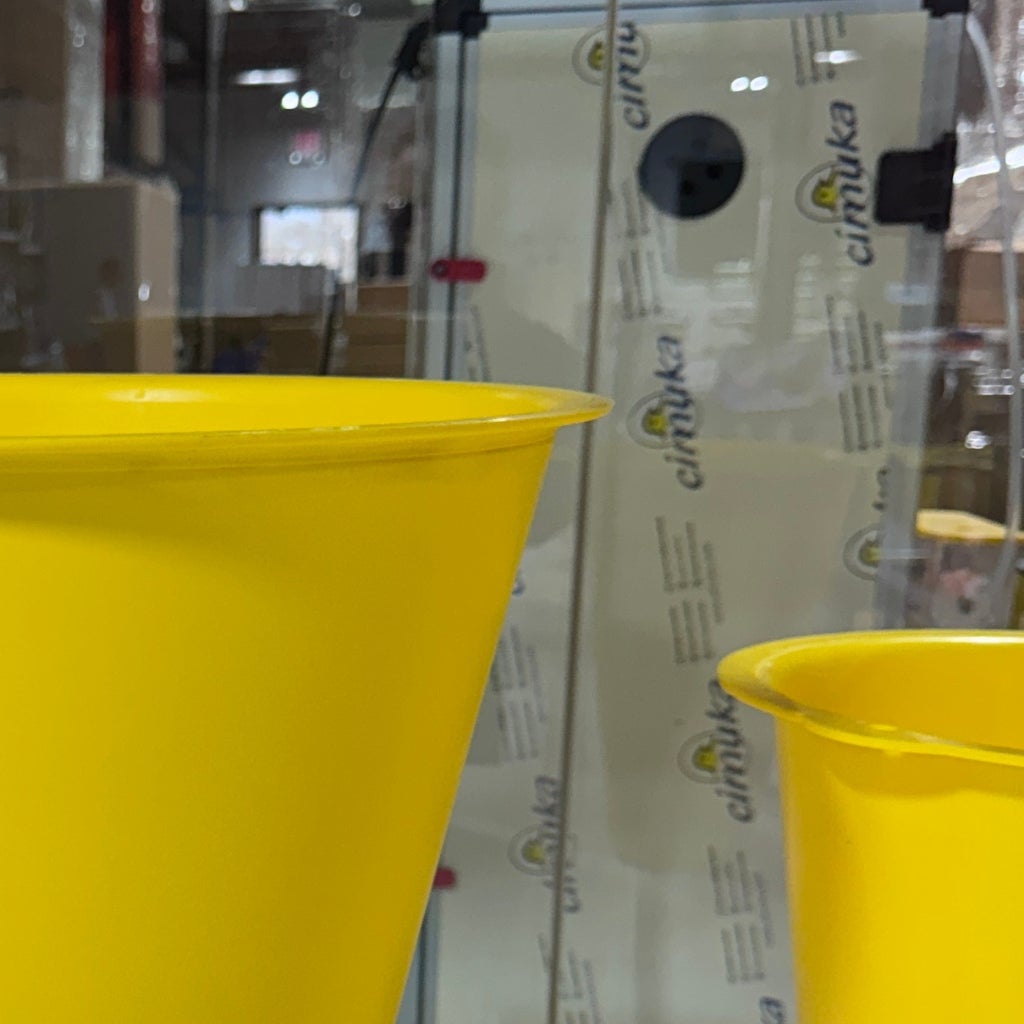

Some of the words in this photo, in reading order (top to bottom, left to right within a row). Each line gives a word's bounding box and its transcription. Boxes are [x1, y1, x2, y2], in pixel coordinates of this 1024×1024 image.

[616, 21, 651, 130] cimu
[825, 101, 874, 266] cimuka
[653, 335, 704, 491] cimuka
